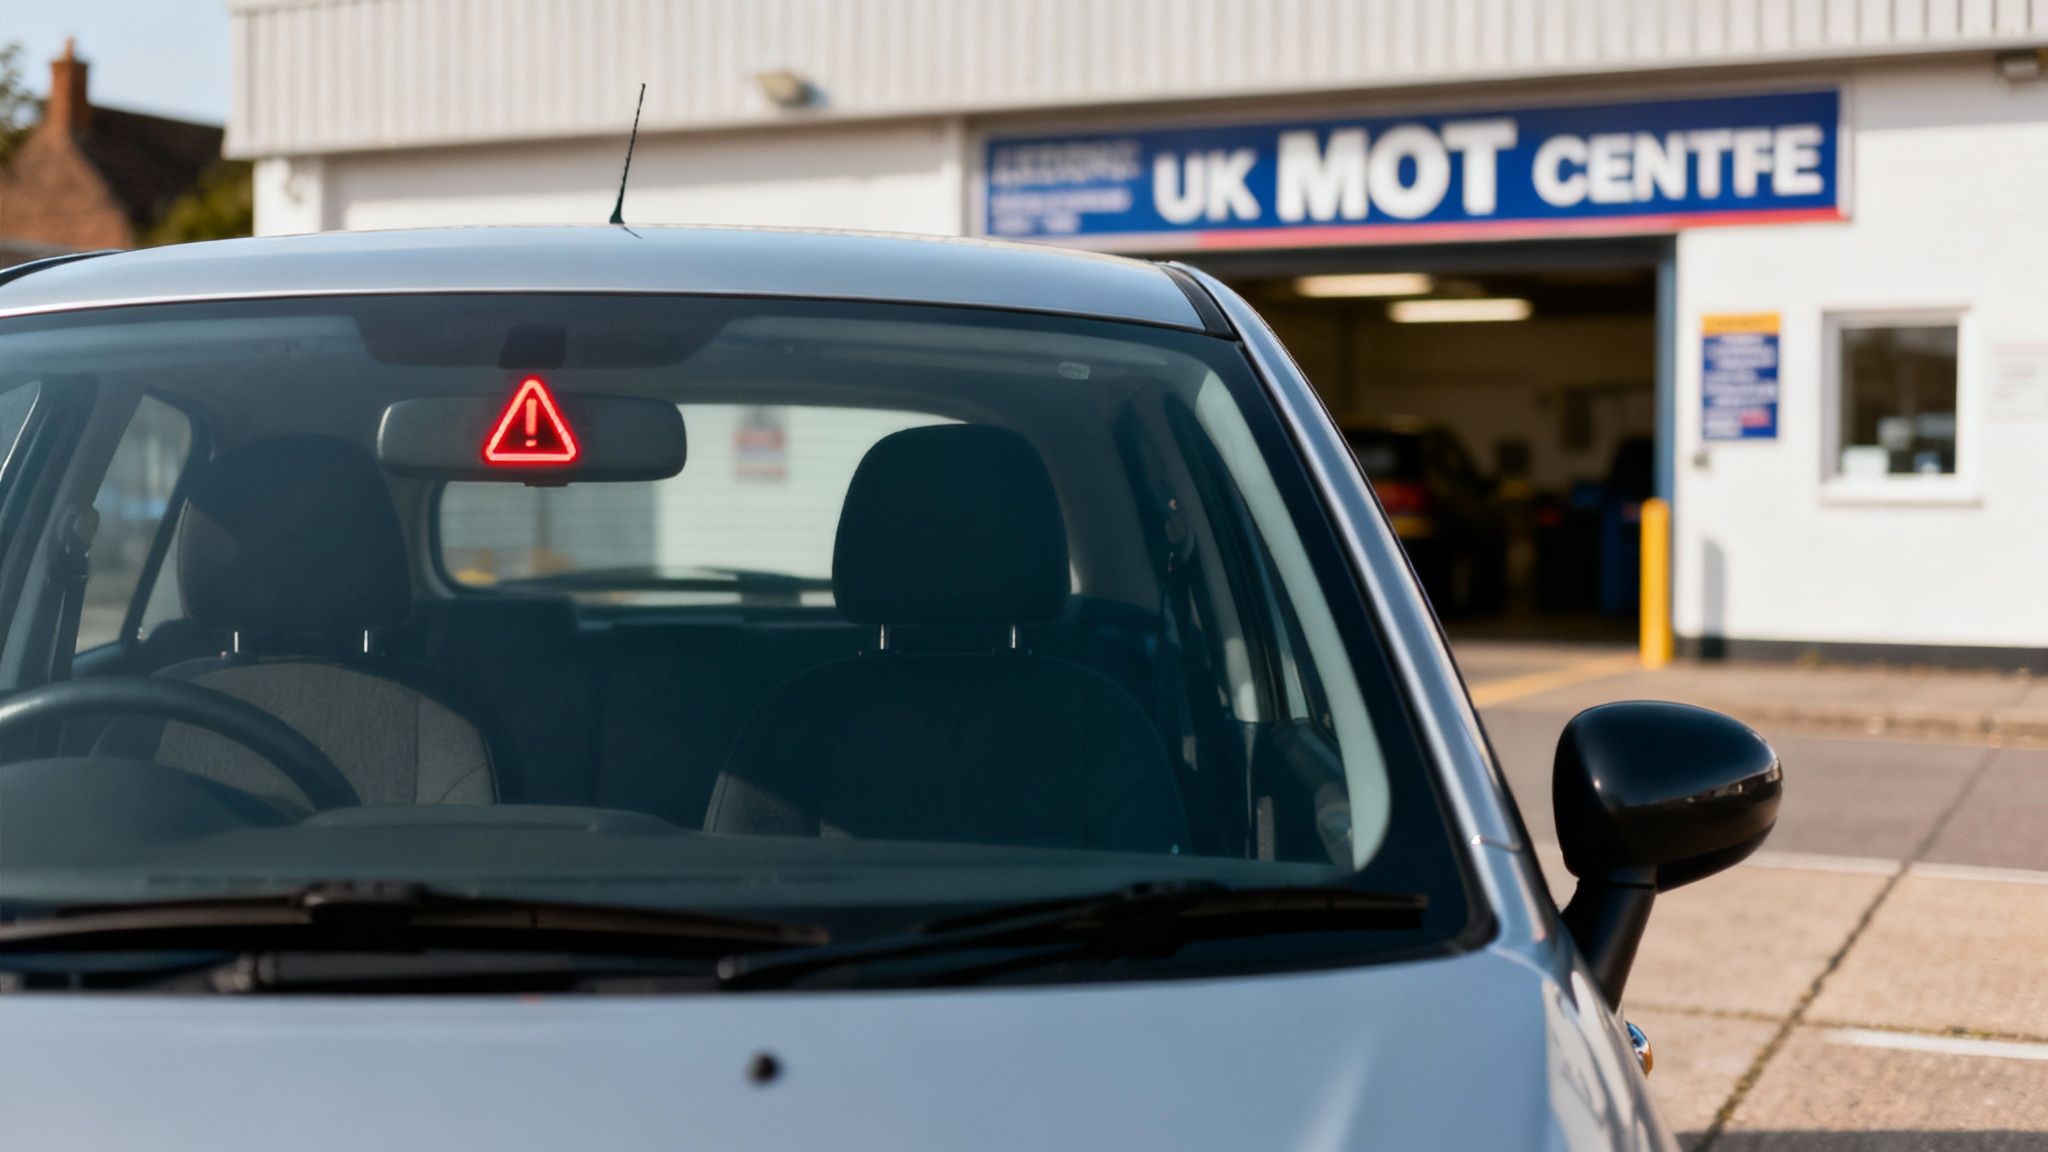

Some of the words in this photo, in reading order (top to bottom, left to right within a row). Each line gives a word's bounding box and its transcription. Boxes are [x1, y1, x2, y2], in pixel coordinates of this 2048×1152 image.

[1153, 151, 1261, 224] UK
[1276, 120, 1517, 222] MOT
[1532, 125, 1823, 207] CENTFE
